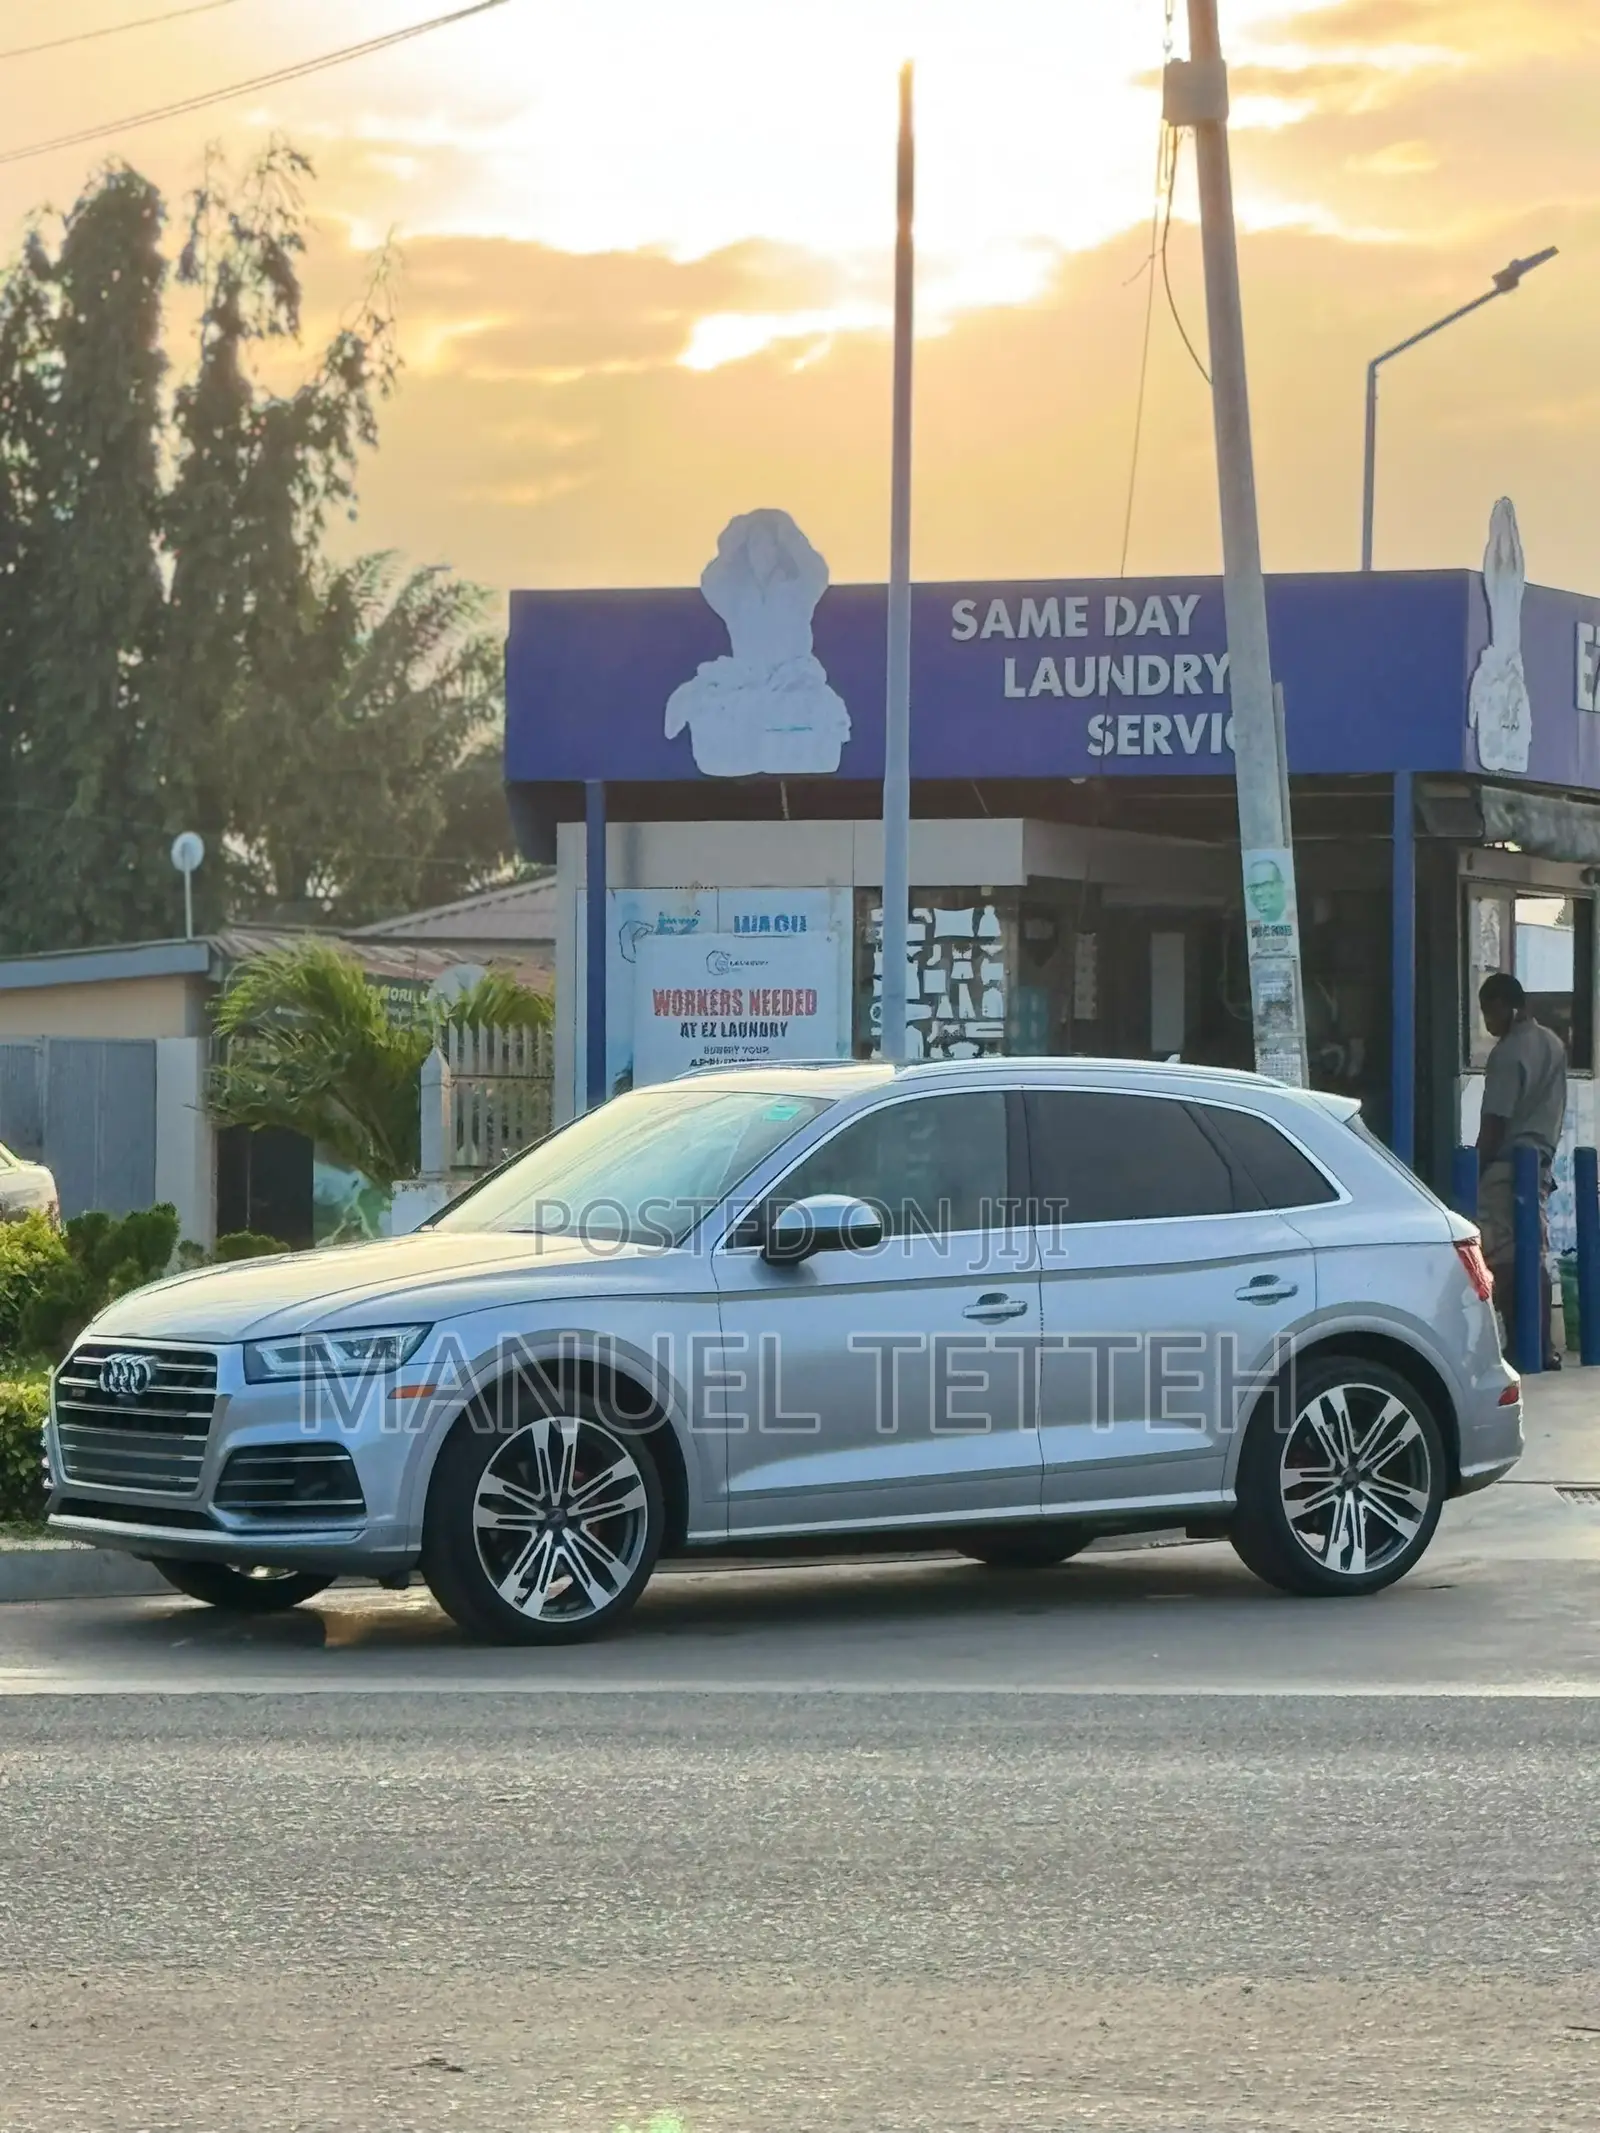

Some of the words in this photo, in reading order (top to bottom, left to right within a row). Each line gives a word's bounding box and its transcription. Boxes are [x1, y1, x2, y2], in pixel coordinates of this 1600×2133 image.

[951, 597, 1089, 642] SAME
[1103, 594, 1201, 637] DAY
[1004, 653, 1231, 698] LAUNDRY
[653, 989, 744, 1016] WORKERS
[749, 989, 817, 1016] NEEDED
[680, 1021, 697, 1038] AT
[720, 1021, 788, 1038] LAUNDRY
